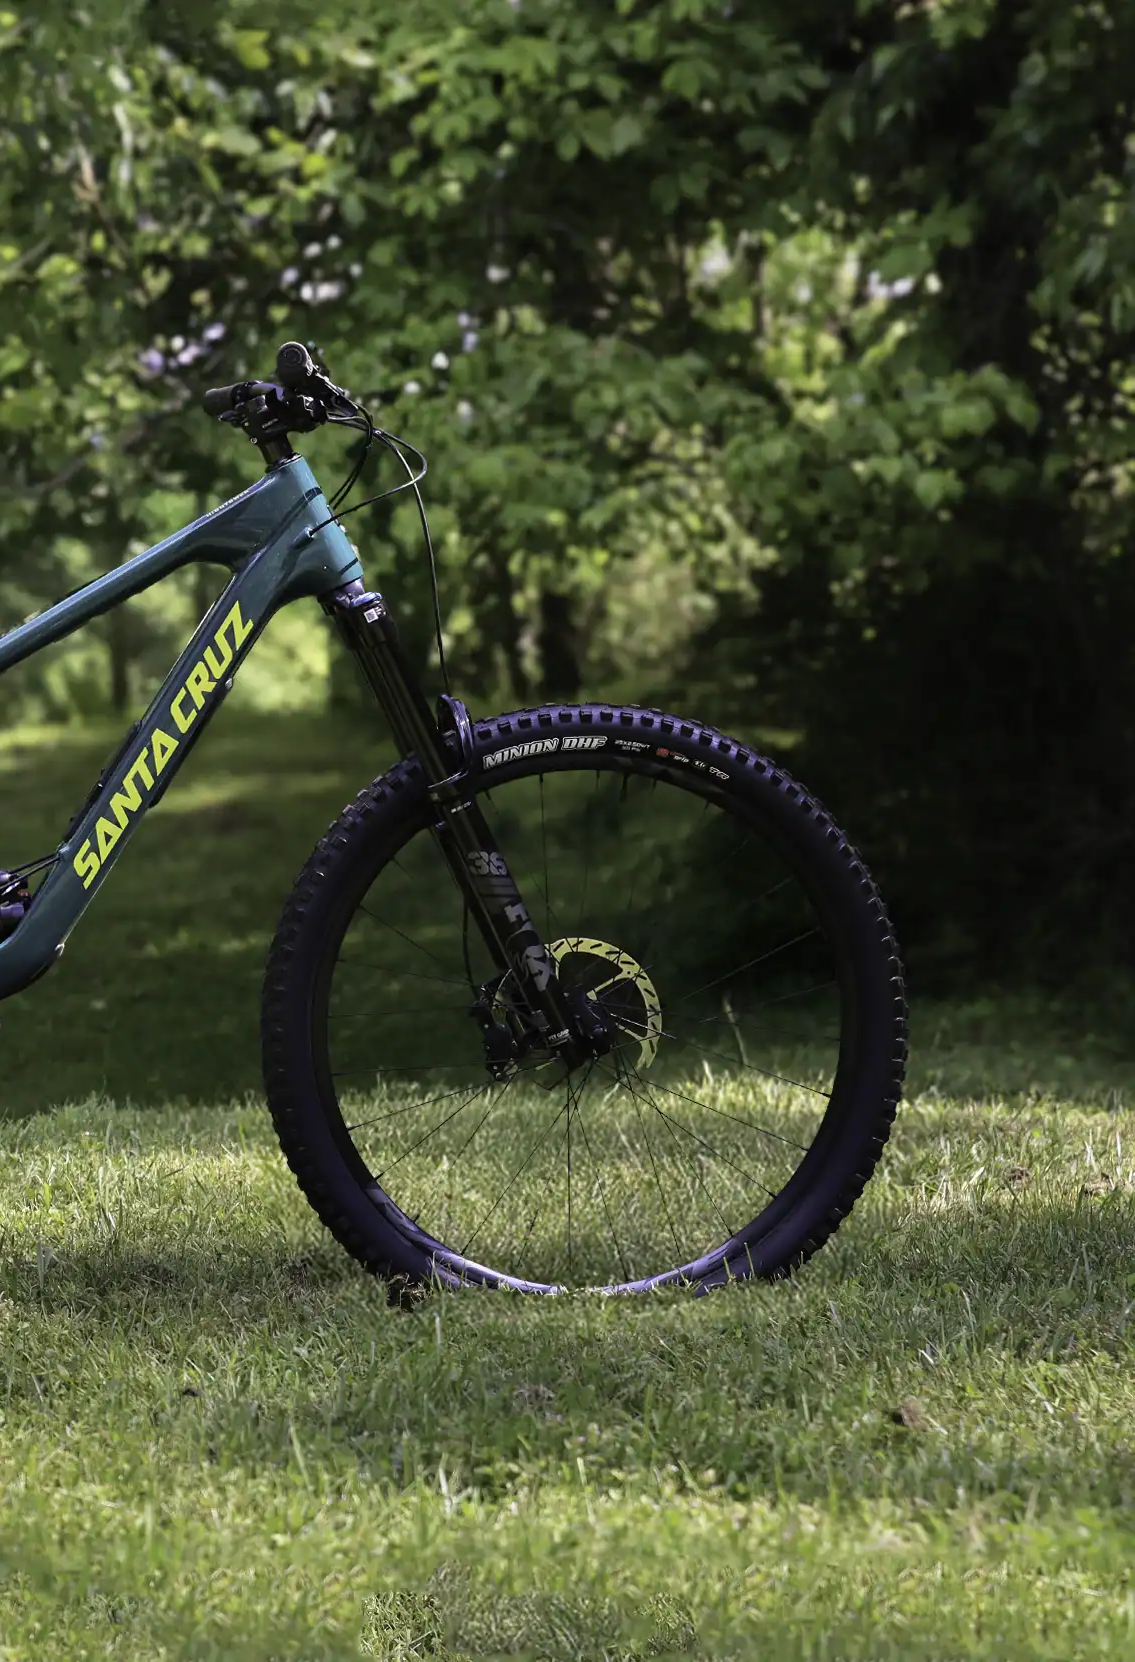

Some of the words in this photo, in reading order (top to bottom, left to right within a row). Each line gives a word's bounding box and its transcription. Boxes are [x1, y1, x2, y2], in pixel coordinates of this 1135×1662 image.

[73, 728, 179, 889] SANTA
[170, 600, 254, 734] CRUZ
[483, 737, 560, 770] MINION
[562, 735, 608, 751] DHF
[466, 850, 508, 876] 36
